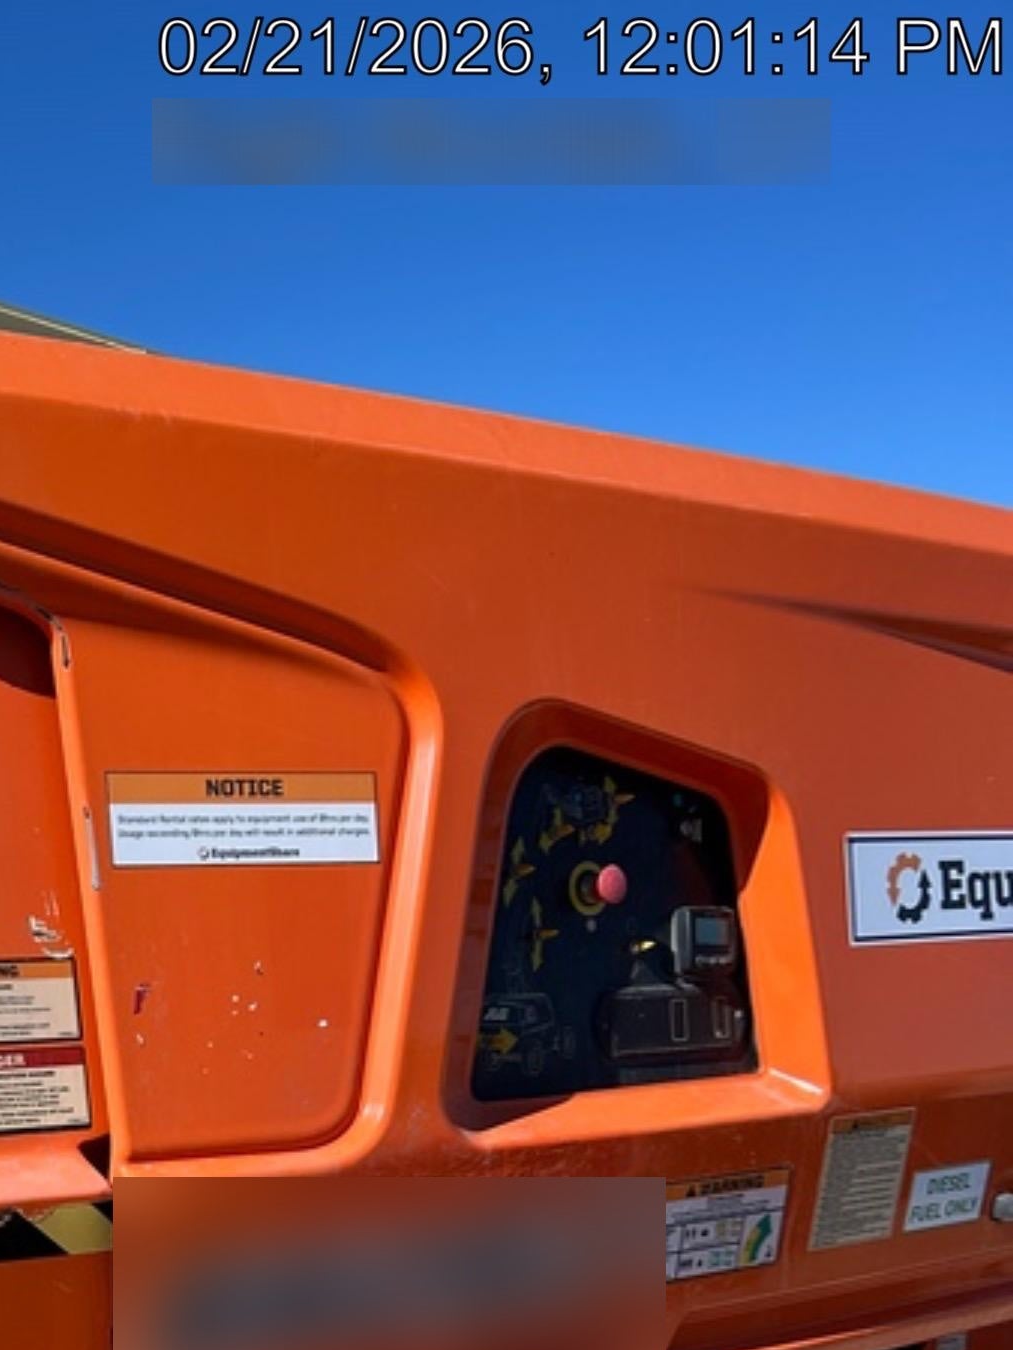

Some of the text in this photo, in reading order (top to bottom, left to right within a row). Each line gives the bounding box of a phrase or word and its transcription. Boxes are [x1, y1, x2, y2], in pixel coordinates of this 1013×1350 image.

[205, 778, 284, 797] NOTICE
[926, 1172, 972, 1195] DIESEL
[910, 1197, 979, 1222] FUEL ONLY
